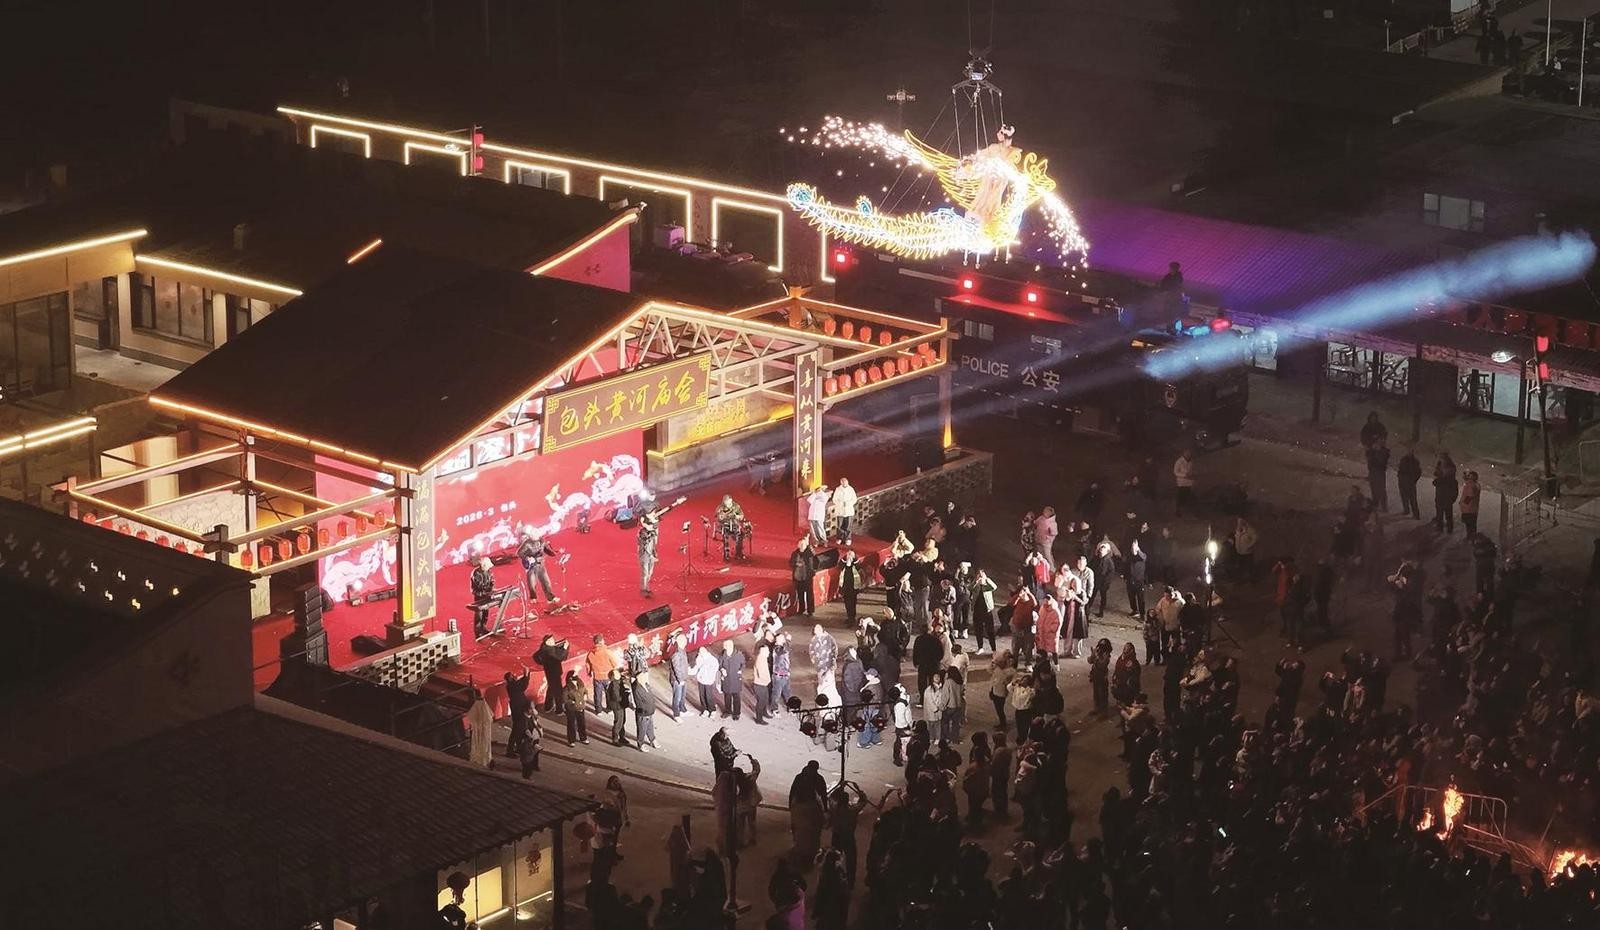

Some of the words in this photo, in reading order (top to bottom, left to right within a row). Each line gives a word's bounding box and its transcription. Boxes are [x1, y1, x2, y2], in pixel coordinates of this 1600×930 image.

[961, 355, 1009, 379] POLICE
[1021, 365, 1061, 393] 公安
[560, 370, 695, 435] 包头黄河庙会
